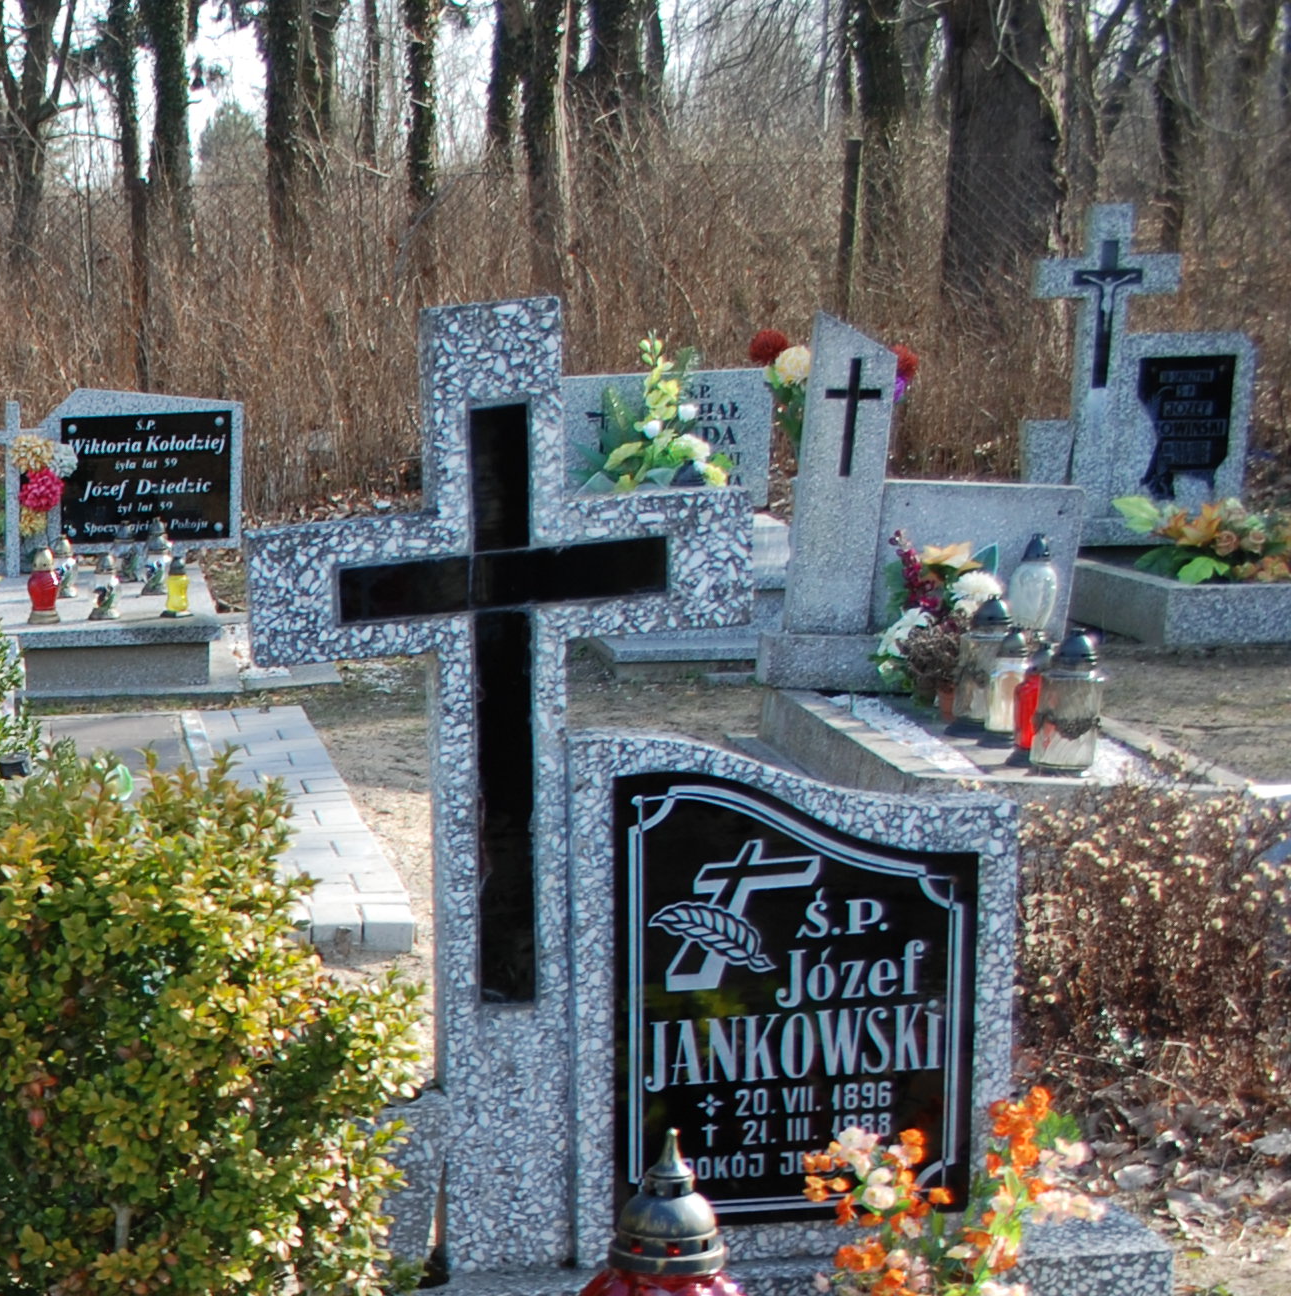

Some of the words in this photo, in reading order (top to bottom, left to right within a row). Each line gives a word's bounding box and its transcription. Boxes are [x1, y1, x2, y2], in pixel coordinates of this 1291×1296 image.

[69, 437, 142, 455] Wiktoria
[145, 433, 227, 455] Kołodziej
[142, 457, 158, 469] lat
[79, 479, 130, 502] Józef
[136, 477, 212, 496] Dziedzic
[795, 887, 890, 939] Ś.P.
[775, 940, 925, 1009] Józef
